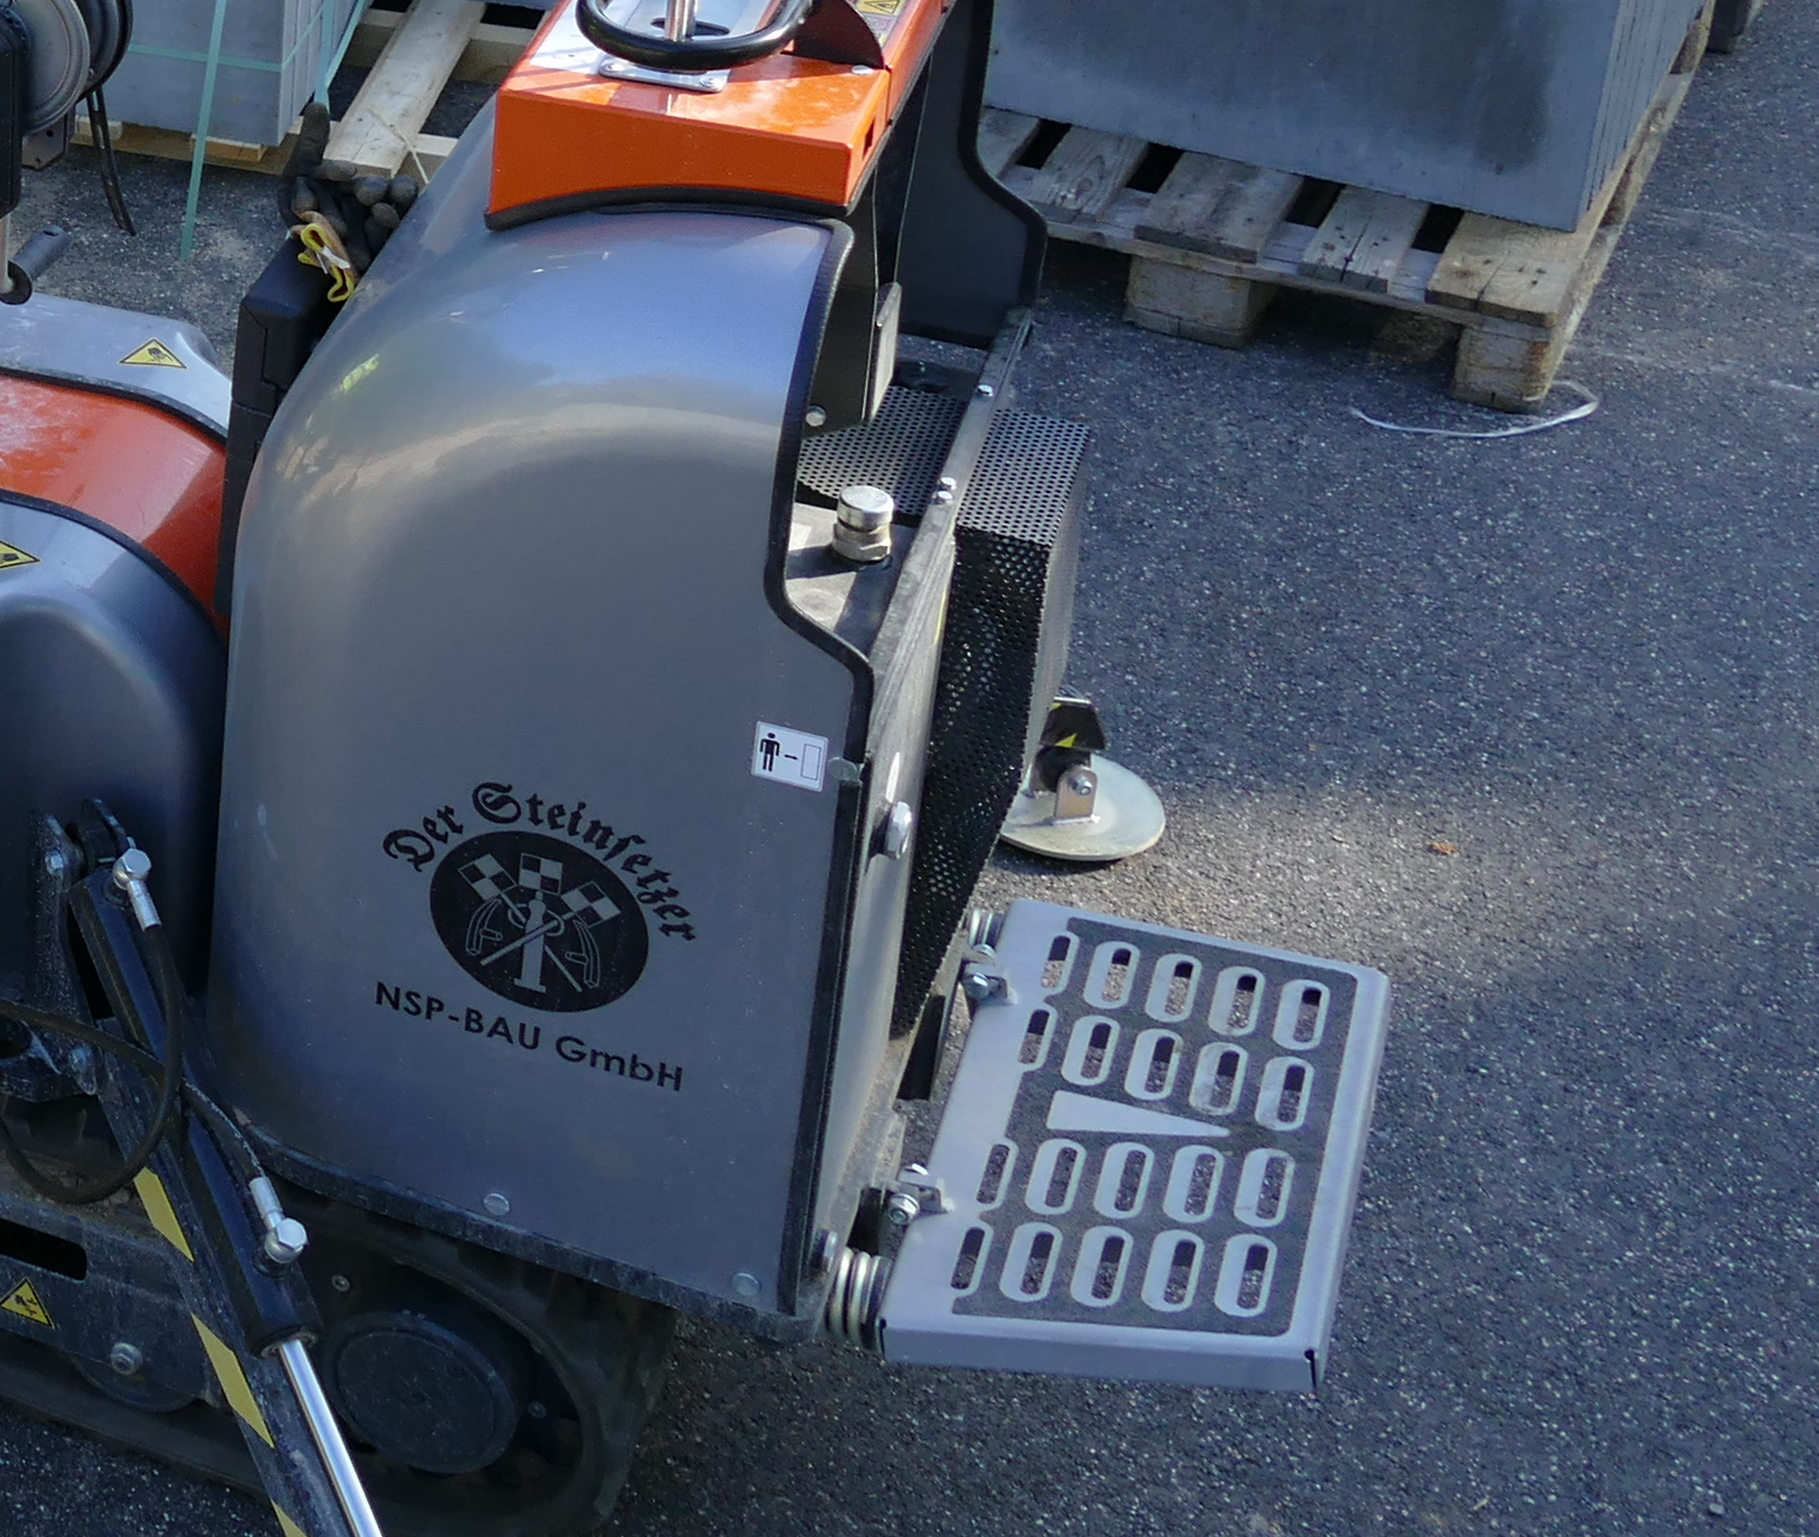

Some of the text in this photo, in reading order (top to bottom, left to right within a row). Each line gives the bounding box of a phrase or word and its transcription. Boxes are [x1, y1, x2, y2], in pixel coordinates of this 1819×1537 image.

[382, 804, 464, 872] Der
[375, 982, 684, 1091] NSP-BAU GmbH
